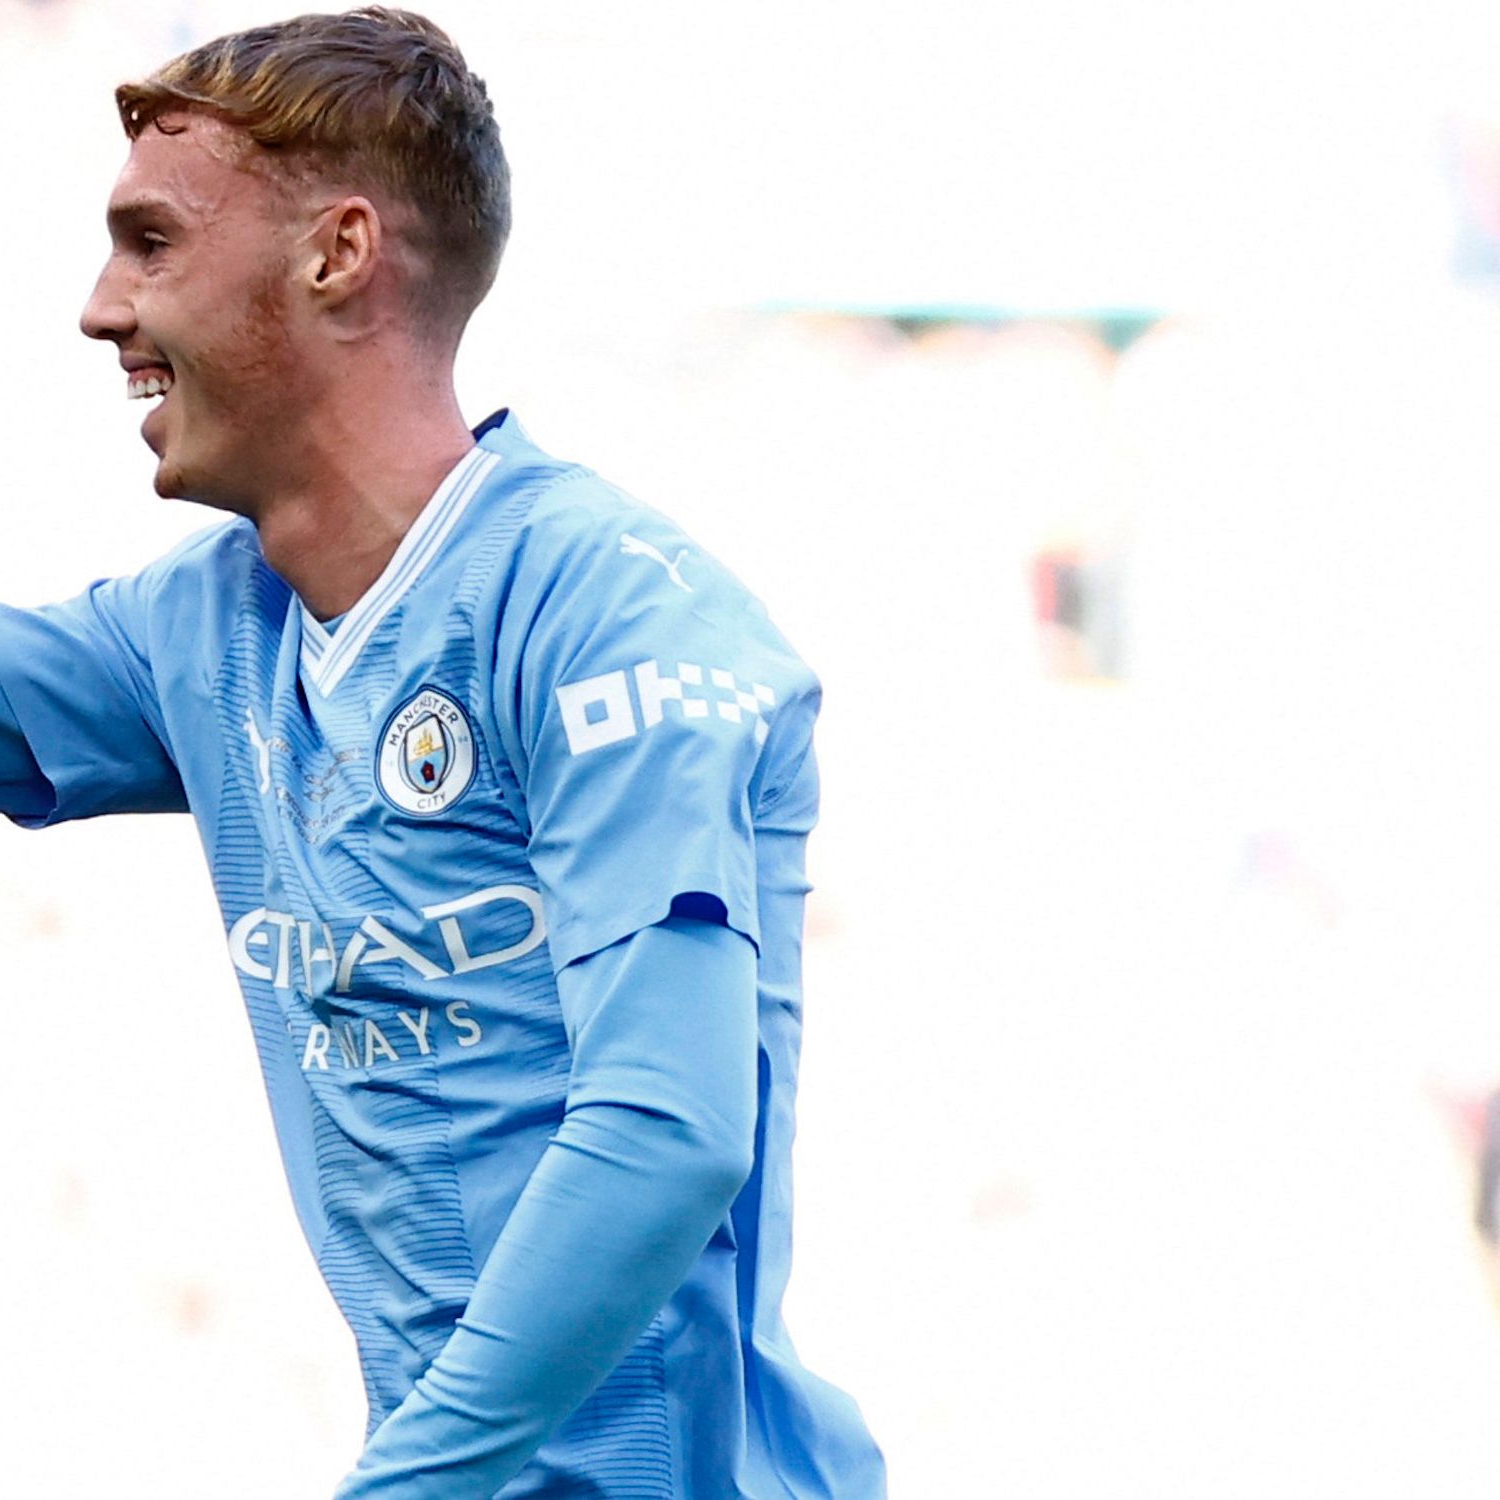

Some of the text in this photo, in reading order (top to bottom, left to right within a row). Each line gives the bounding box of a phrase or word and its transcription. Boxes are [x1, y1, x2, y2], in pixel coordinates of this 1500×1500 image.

[416, 792, 447, 810] CITY
[228, 884, 548, 995] ETHAD
[300, 1000, 482, 1070] RWAYS
